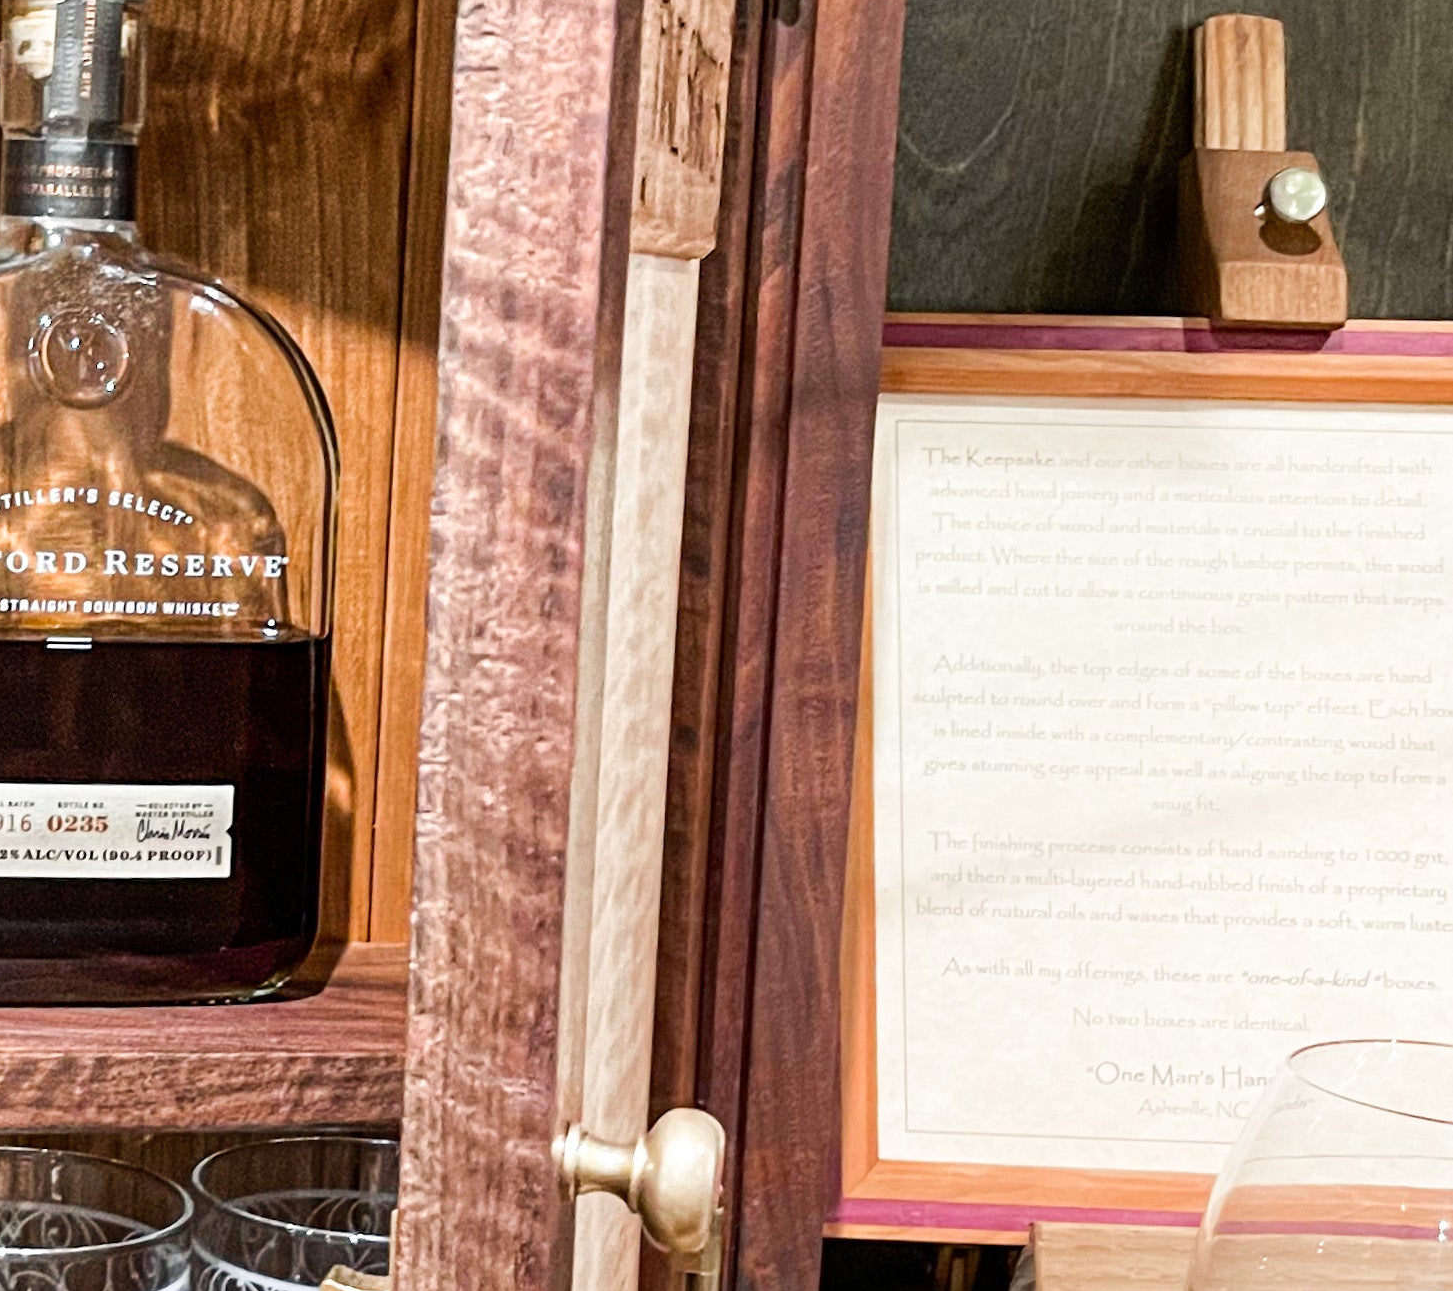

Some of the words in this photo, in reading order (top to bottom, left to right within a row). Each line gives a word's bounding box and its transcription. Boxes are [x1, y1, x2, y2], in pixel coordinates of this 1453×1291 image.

[922, 447, 960, 466] The
[966, 447, 1054, 472] Keepsake
[1059, 451, 1091, 467] and
[1095, 459, 1125, 468] our
[1127, 452, 1173, 469] other
[1178, 453, 1229, 470] boxes
[1234, 462, 1261, 471] are
[1265, 455, 1284, 472] all
[1288, 455, 1393, 474] handcrafted
[1397, 458, 1432, 475] with
[0, 598, 76, 614] STRAIGHT
[83, 599, 157, 615] BOURBON
[47, 814, 109, 833] 0235
[23, 848, 98, 862] ALC/VOL
[148, 848, 212, 862] PROOF)
[927, 831, 967, 852] The
[973, 832, 1044, 858] finishing
[1048, 843, 1116, 860] process
[1121, 842, 1192, 856] consists
[1197, 839, 1214, 857] of
[1219, 840, 1262, 858] hand
[1268, 842, 1336, 867] sanding
[1340, 848, 1358, 861] to
[1366, 849, 1410, 863] 1000
[1414, 852, 1449, 869] grit,
[931, 866, 963, 884] and
[967, 866, 1005, 883] then
[1010, 875, 1020, 885] a
[1025, 867, 1135, 894] multi-layered
[1140, 870, 1253, 892] hand-rubbed
[1258, 874, 1304, 893] finish
[1308, 876, 1328, 894] of
[1333, 885, 1342, 895] a
[1348, 882, 1447, 905] proprietary
[916, 896, 964, 916] blend
[969, 899, 988, 917] of
[991, 901, 1052, 919] natural
[1056, 902, 1085, 920] oils
[1090, 904, 1122, 922] and
[1127, 913, 1179, 923] waxes
[1183, 906, 1219, 925] that
[1223, 909, 1298, 932] provides
[1303, 918, 1313, 927] a
[1318, 910, 1358, 930] soft,
[1362, 921, 1406, 930] warm
[941, 957, 971, 977] As
[975, 958, 1010, 975] with
[1015, 959, 1033, 976] all
[1038, 968, 1061, 985] my
[1066, 960, 1148, 986] offerings,
[1154, 964, 1201, 982] these
[1206, 973, 1234, 983] are
[1073, 1007, 1103, 1027] No
[1108, 1014, 1140, 1026] two
[1144, 1008, 1196, 1028] boxes
[1201, 1019, 1228, 1029] are
[1233, 1012, 1311, 1032] identical.
[1152, 1064, 1214, 1087] Man's
[1221, 1066, 1273, 1089] Han
